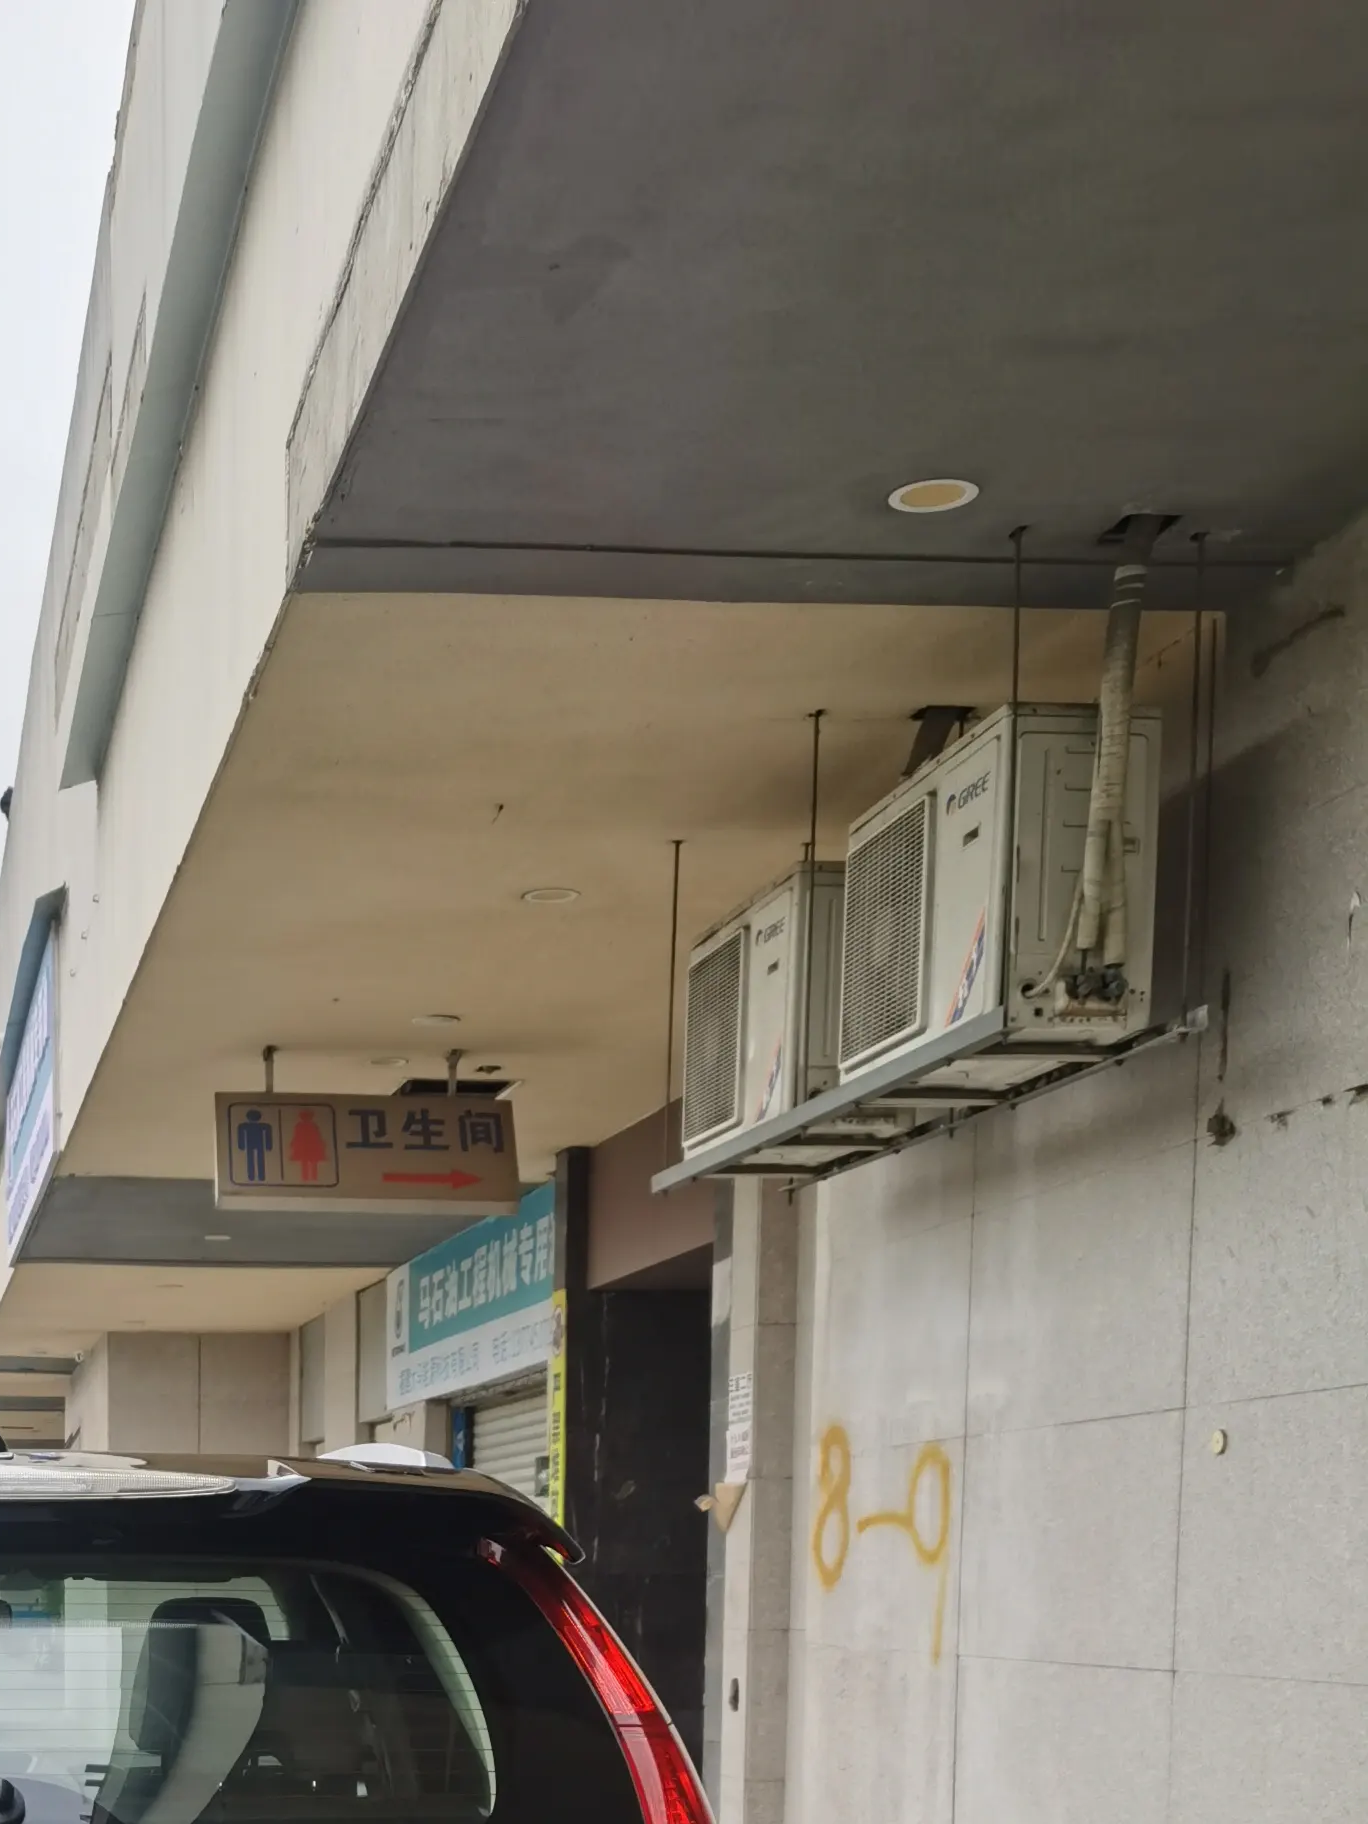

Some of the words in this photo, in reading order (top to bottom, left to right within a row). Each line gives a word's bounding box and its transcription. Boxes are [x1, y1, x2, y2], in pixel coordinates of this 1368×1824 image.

[958, 770, 991, 809] GREE
[346, 1107, 505, 1153] 卫生间
